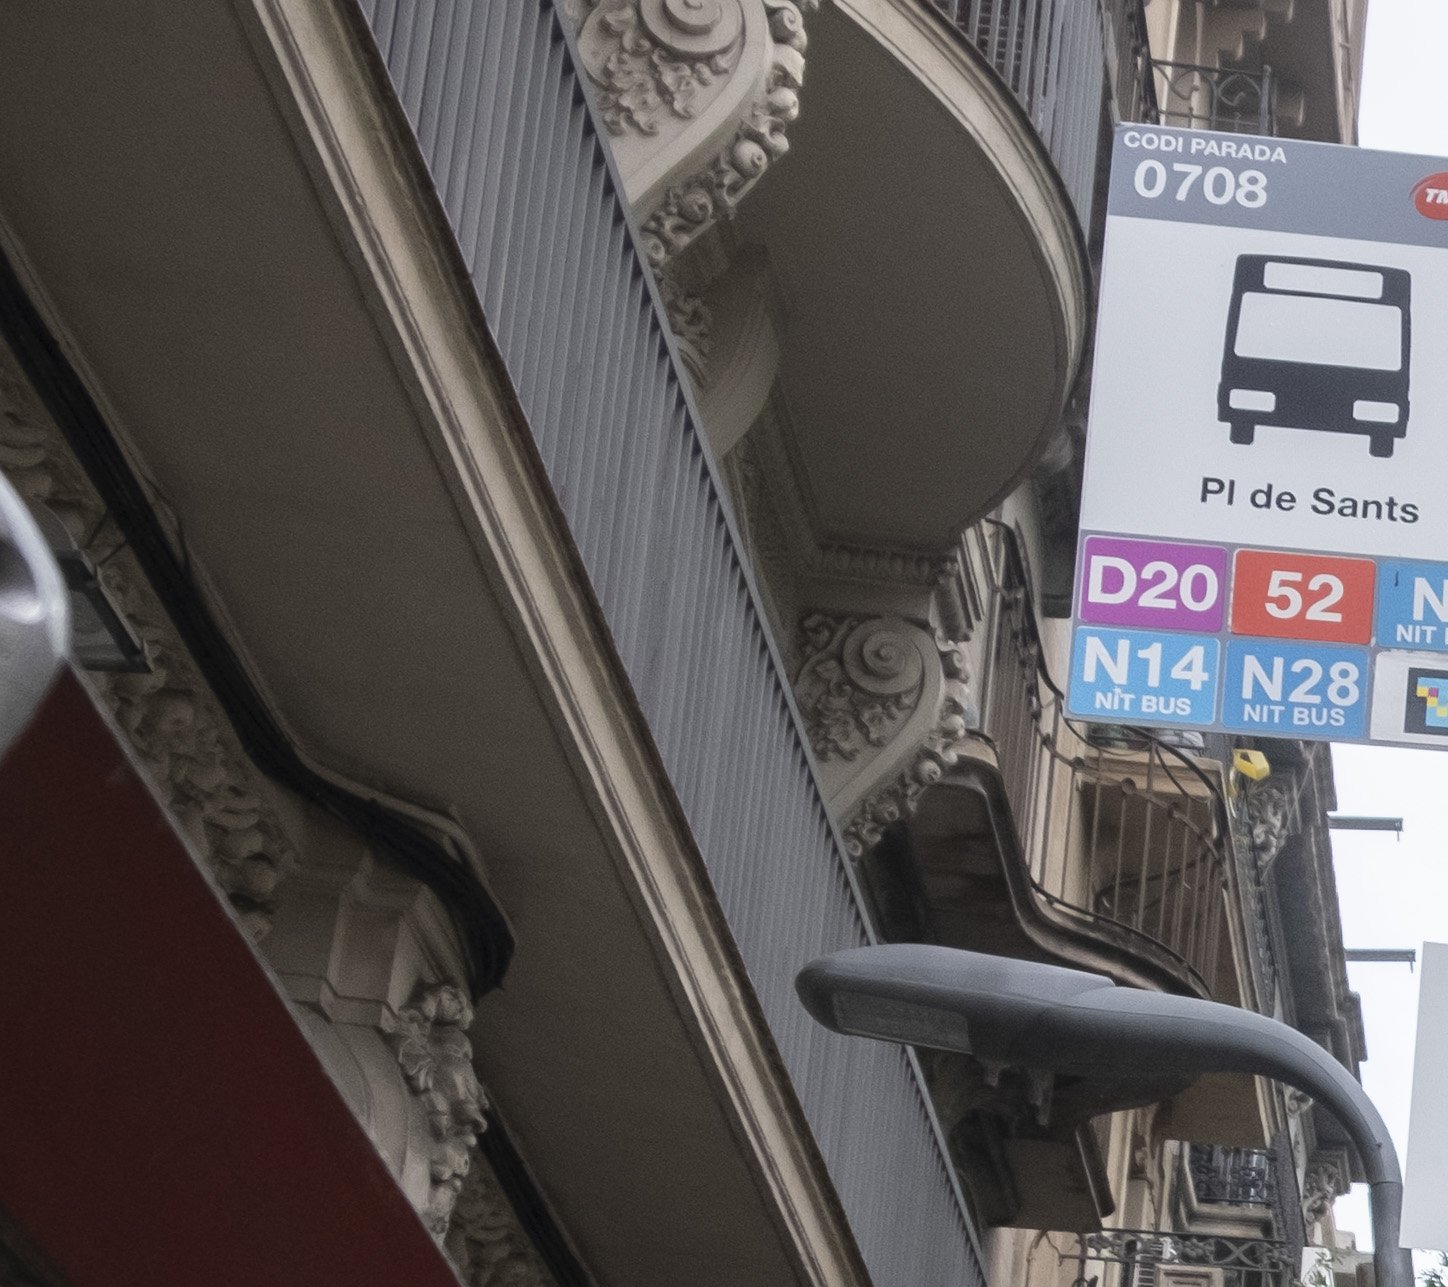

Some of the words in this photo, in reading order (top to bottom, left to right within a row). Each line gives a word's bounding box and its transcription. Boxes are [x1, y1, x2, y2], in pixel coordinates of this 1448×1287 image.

[1123, 131, 1184, 154] CODI
[1189, 138, 1288, 164] PARADA
[1133, 159, 1269, 209] 0708
[1200, 477, 1235, 506] Pl
[1249, 483, 1297, 512] de
[1311, 488, 1420, 524] Sants
[1087, 555, 1220, 613] D20
[1264, 571, 1344, 624] 52
[1396, 623, 1445, 646] NIT
[1082, 636, 1210, 692] N14
[1241, 658, 1360, 706] N28
[1094, 690, 1136, 711] NIT
[1141, 695, 1192, 717] BUS
[1243, 703, 1287, 724] NIT
[1294, 707, 1345, 728] BUS
